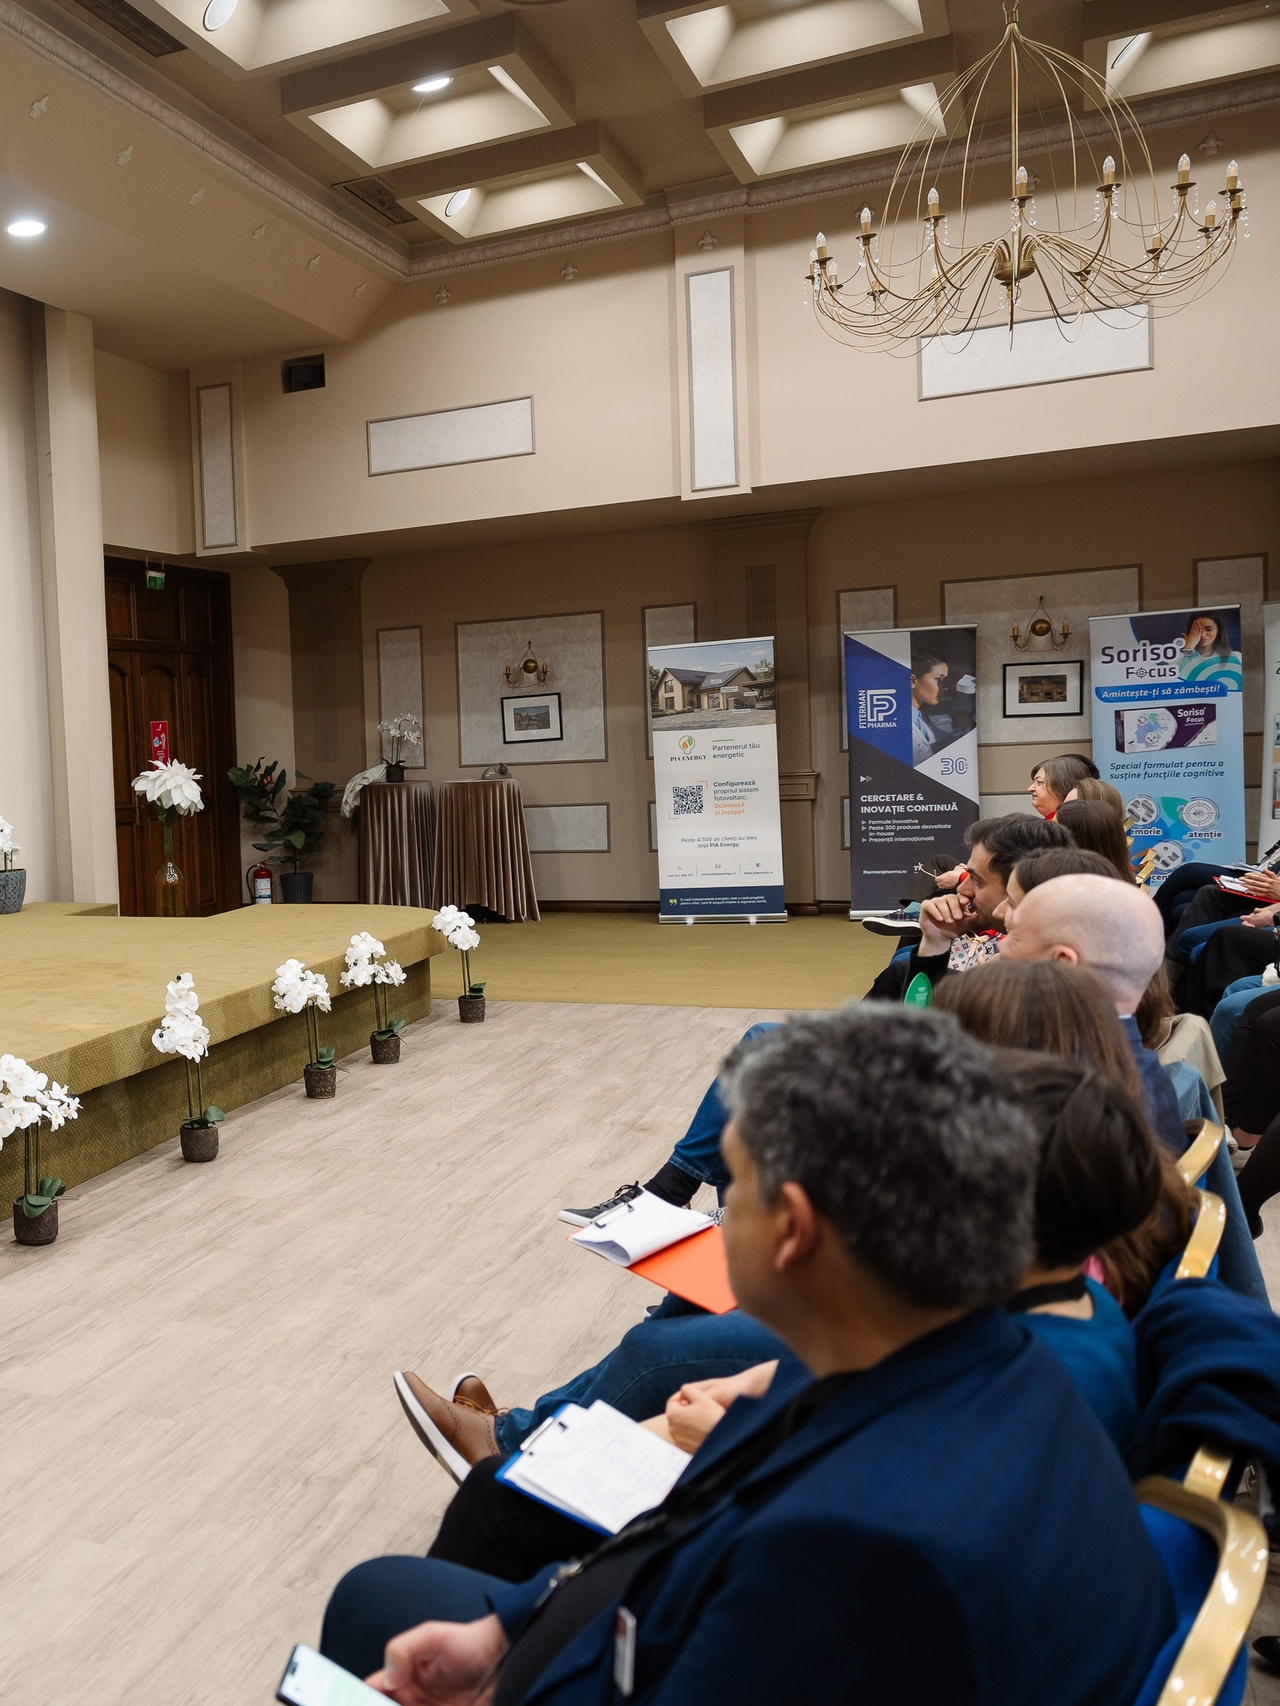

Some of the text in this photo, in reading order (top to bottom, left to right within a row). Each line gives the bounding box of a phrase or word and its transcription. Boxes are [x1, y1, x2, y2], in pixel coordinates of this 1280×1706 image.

[1161, 687, 1172, 695] să
[1174, 685, 1221, 696] zâmbești!
[858, 689, 867, 729] FITERMAN
[712, 743, 748, 751] Partenerul
[712, 751, 745, 760] energetic
[1110, 762, 1142, 771] Special
[1143, 761, 1184, 770] formulat
[1185, 760, 1216, 769] pentru
[1110, 769, 1225, 781] susține funcțiile cognitive
[713, 780, 756, 788] Configurează
[860, 793, 924, 802] CERCETARE &
[860, 801, 958, 815] INOVAȚIE CONTINUĂ
[1188, 830, 1223, 840] atenție
